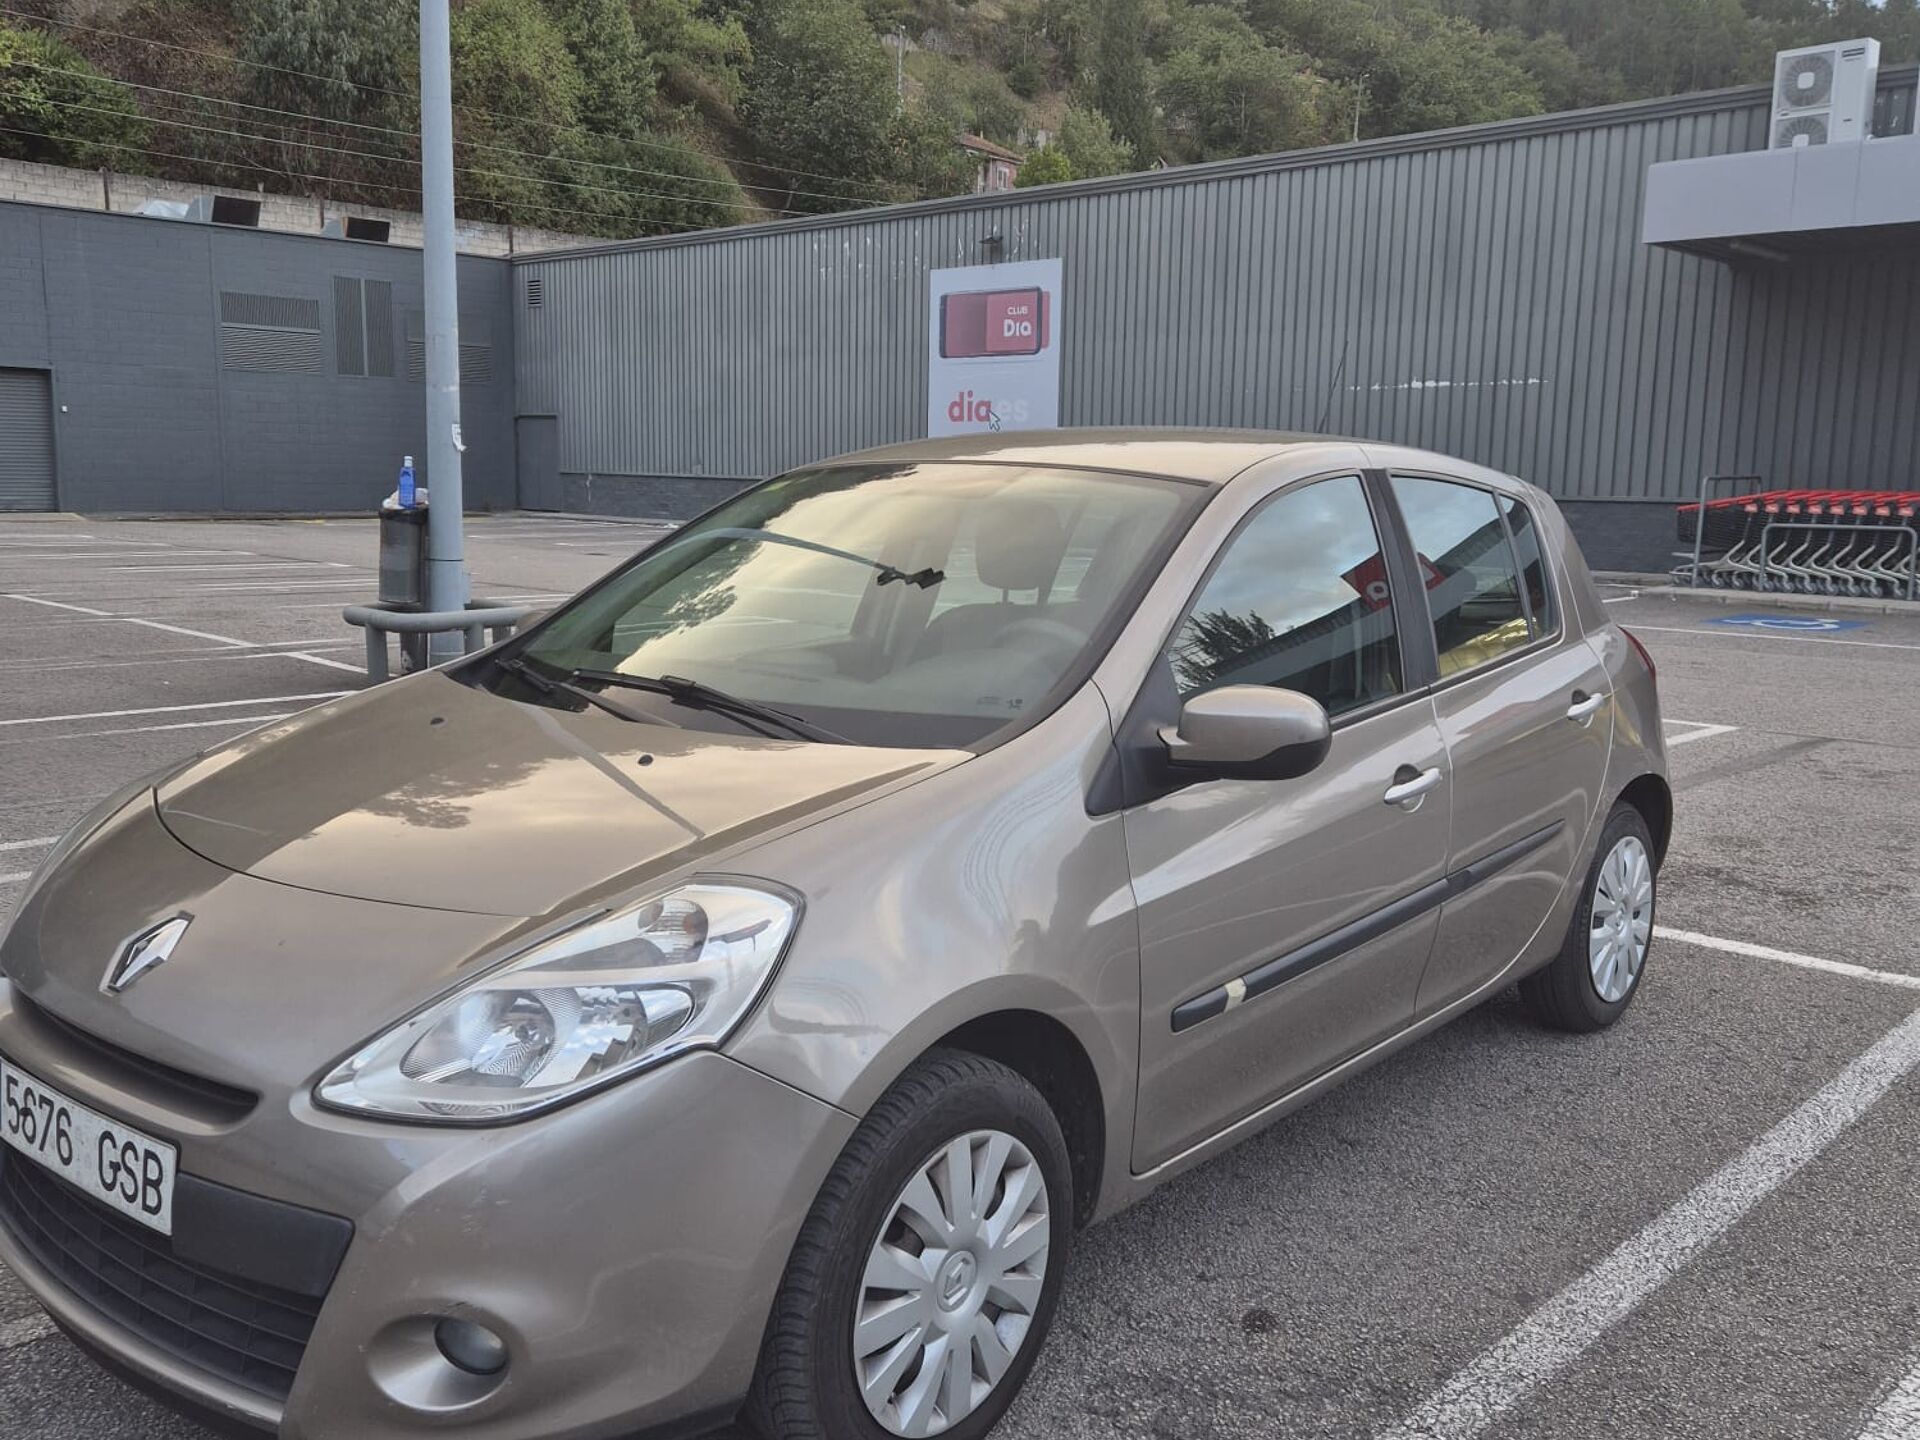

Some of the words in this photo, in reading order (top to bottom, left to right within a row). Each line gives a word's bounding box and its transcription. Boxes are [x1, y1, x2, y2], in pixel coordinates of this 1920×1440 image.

[1007, 306, 1028, 315] CLUB
[6, 1074, 73, 1166] 5676
[98, 1130, 163, 1216] GSB
